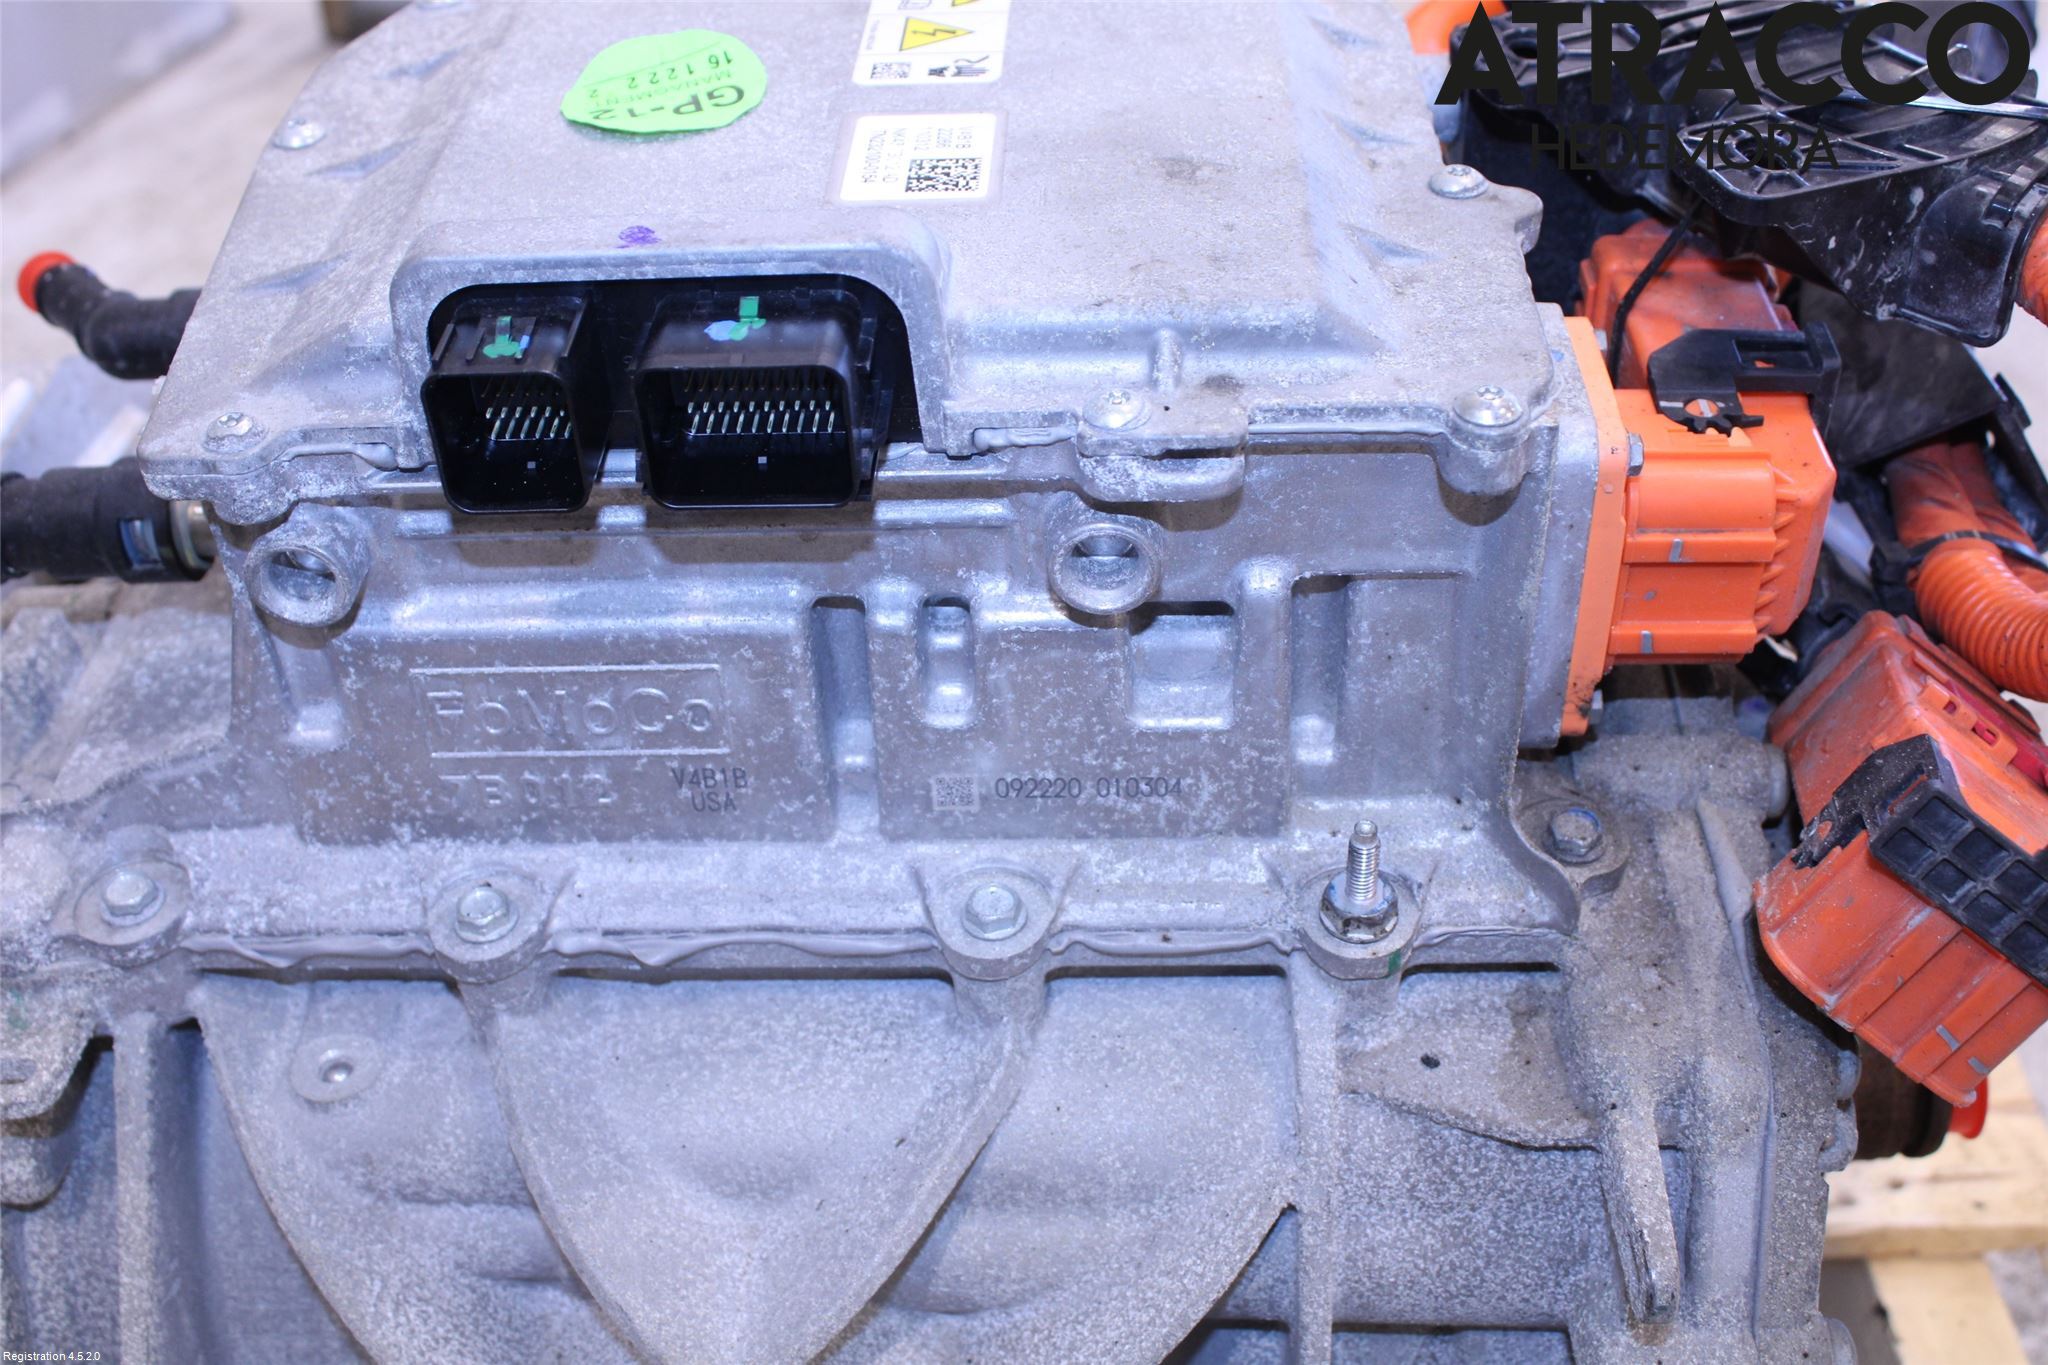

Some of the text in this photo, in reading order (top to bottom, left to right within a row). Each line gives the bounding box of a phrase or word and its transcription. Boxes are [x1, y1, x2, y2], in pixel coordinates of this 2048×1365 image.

[589, 85, 745, 120] GP-12
[671, 767, 748, 790] V4B1B
[994, 776, 1182, 799] 092220 010304
[691, 791, 738, 812] USA
